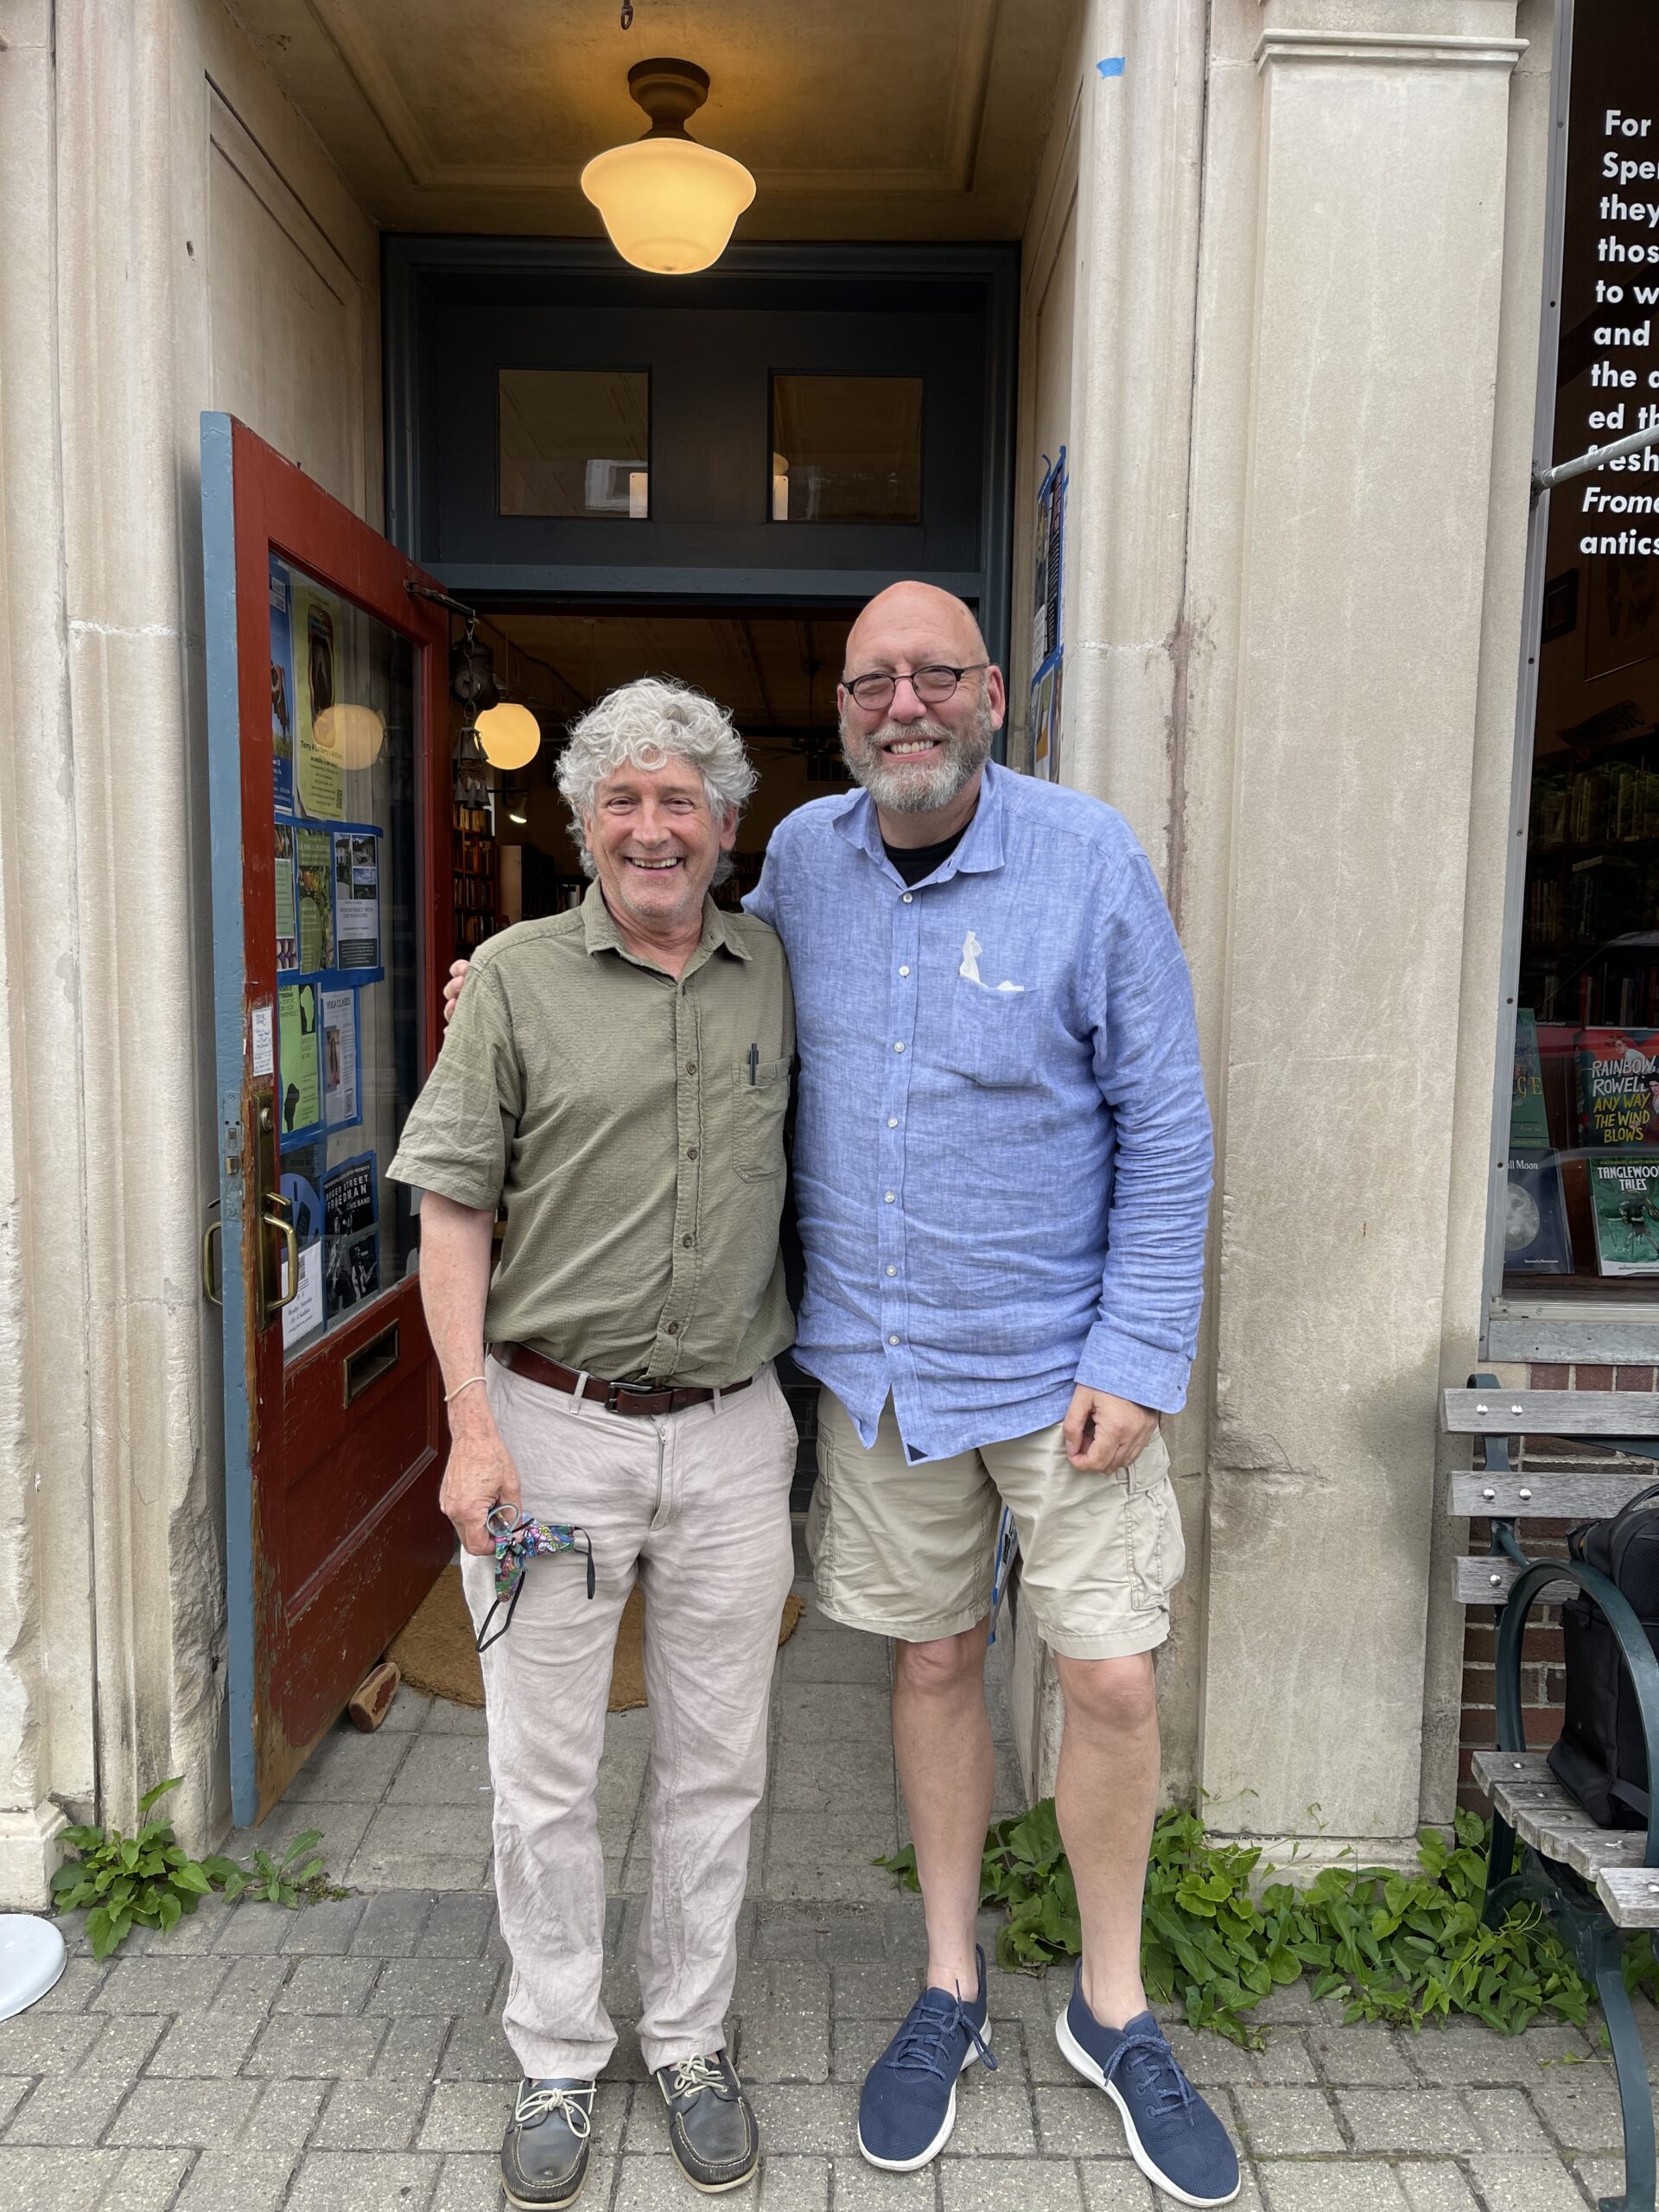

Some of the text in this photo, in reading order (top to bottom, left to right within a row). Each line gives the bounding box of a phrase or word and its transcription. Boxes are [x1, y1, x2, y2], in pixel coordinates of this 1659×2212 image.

[1605, 109, 1651, 137] For
[1602, 151, 1659, 185] Spe
[1599, 194, 1659, 228] they
[1595, 279, 1624, 303] to
[1593, 320, 1650, 346] and
[1591, 360, 1637, 388] the
[1588, 403, 1625, 429] ed
[1587, 444, 1659, 472] esh
[327, 1000, 337, 1010] YOGA
[1592, 1055, 1656, 1078] RAINBOW
[1592, 1076, 1649, 1097] ROWELL
[1592, 1092, 1651, 1114] ANY WAY
[1594, 1109, 1650, 1129] THE WIND
[1604, 1127, 1644, 1143] BLOWS
[1516, 1160, 1539, 1170] Moon
[1597, 1166, 1659, 1179] TANGLEWOO
[343, 1174, 368, 1191] STREET
[1618, 1178, 1648, 1191] TALES
